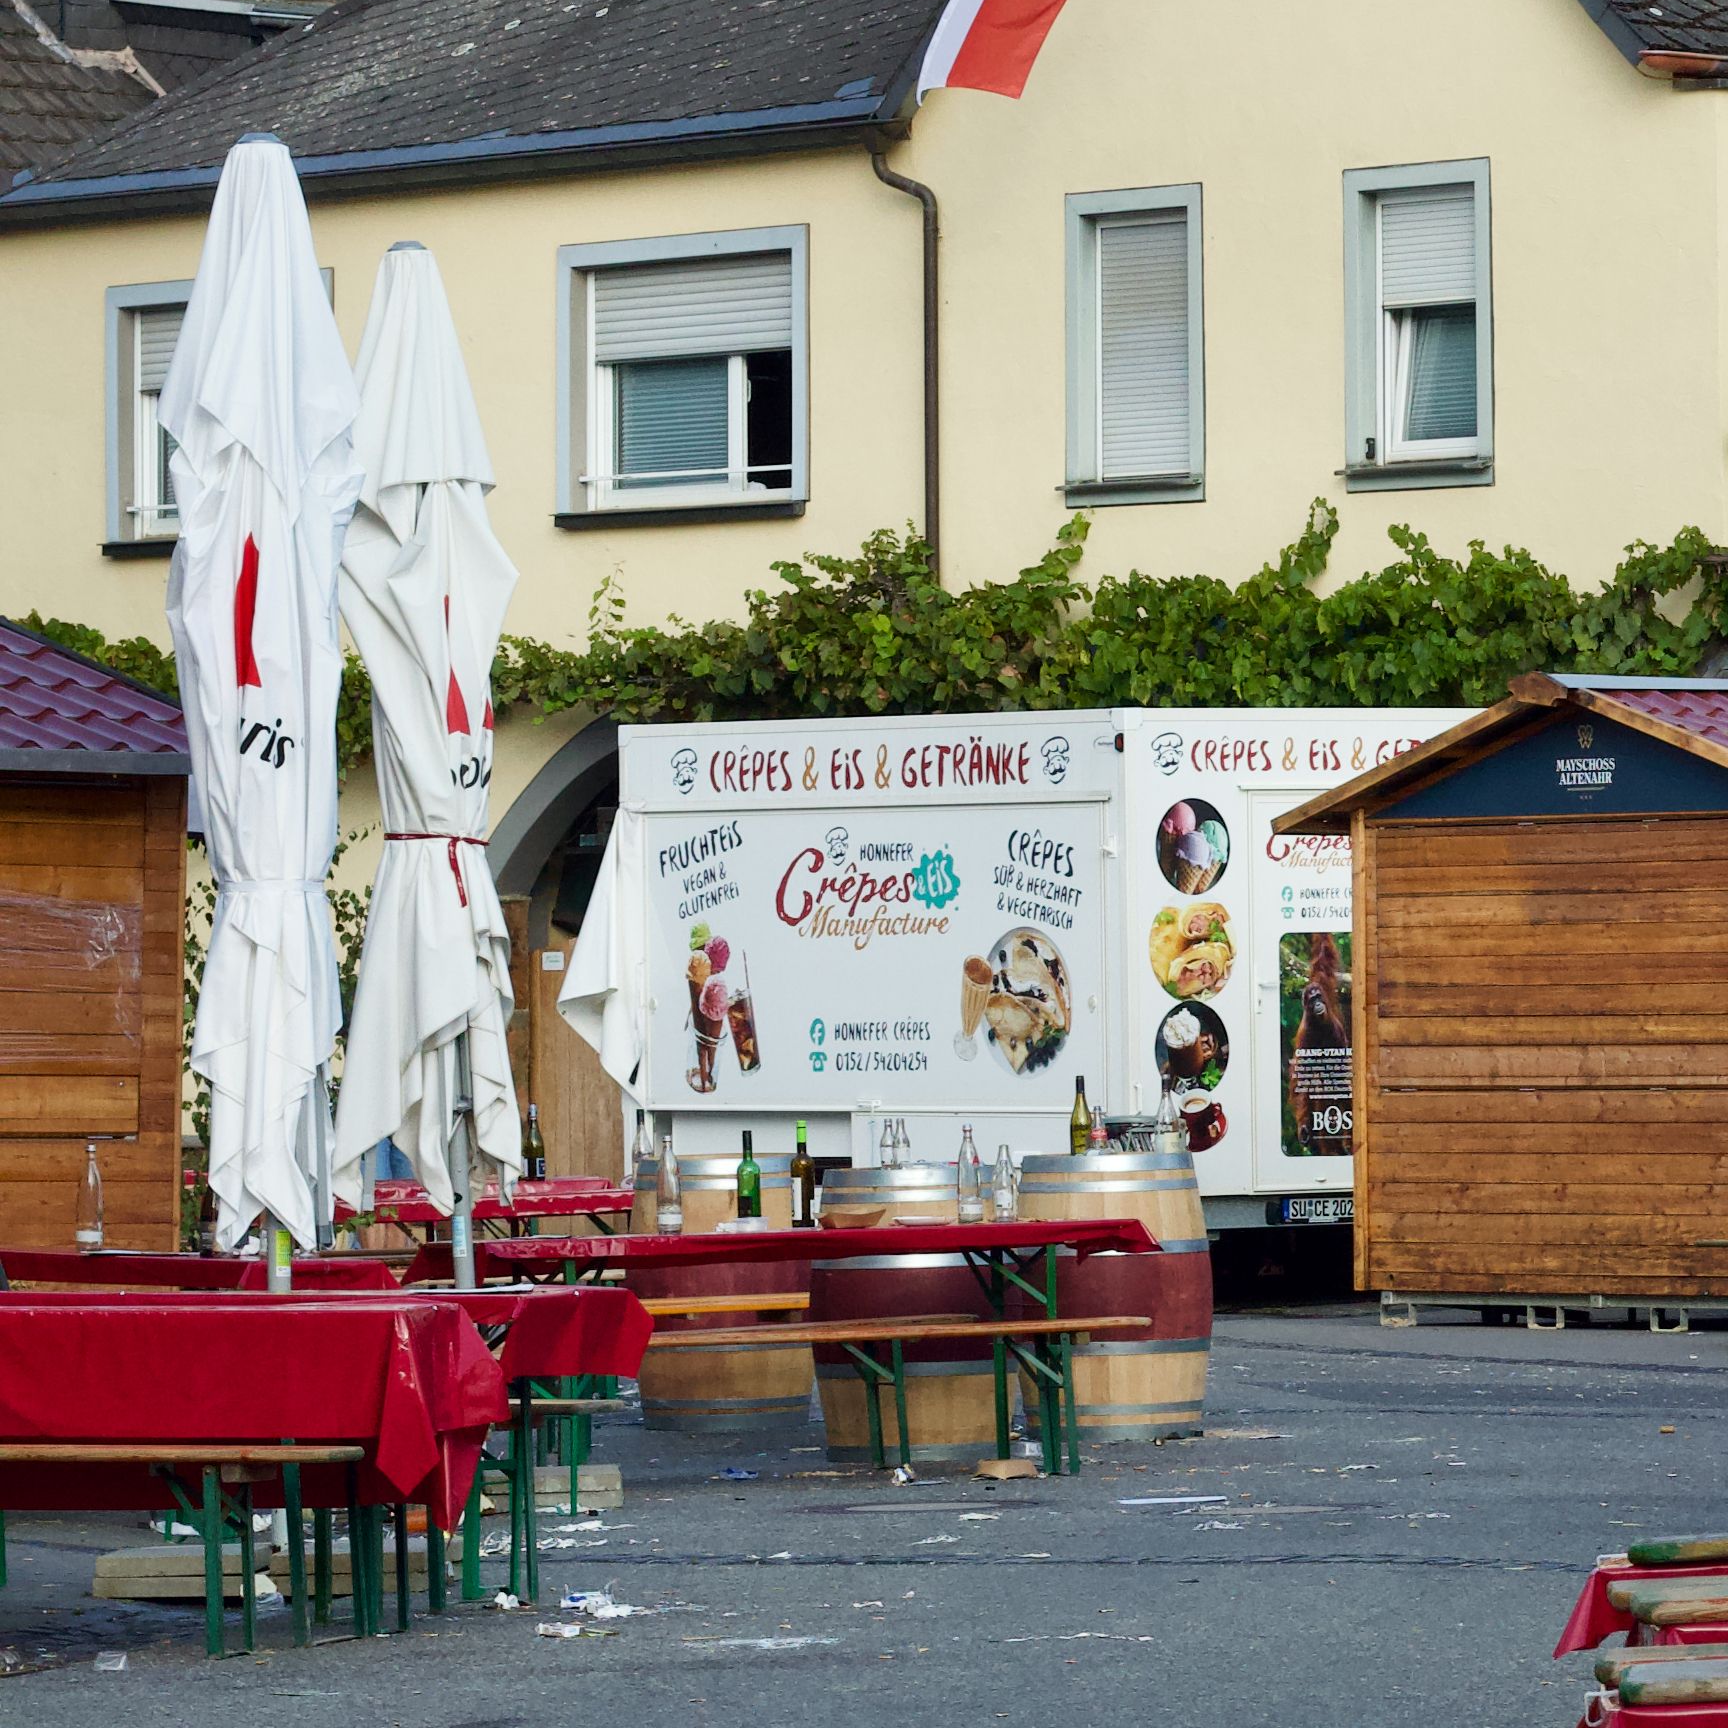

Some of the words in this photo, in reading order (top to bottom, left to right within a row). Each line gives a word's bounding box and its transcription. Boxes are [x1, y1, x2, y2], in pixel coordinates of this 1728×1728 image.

[709, 744, 792, 793] CRÊPES
[802, 746, 819, 791] &
[874, 743, 892, 790] &
[901, 736, 1031, 788] GETRÄNKE
[1191, 736, 1272, 772] CRÊPES
[1282, 737, 1297, 772] &
[1350, 737, 1366, 771] &
[1556, 758, 1616, 772] MAYSCHOSS
[1559, 772, 1612, 785] ALTENAHR
[860, 843, 913, 862] HONNEFER
[1008, 828, 1074, 877] CRÊPES
[683, 866, 717, 894] VEGAN
[719, 862, 727, 879] &
[775, 847, 915, 926] Crêpes
[1016, 872, 1024, 890] &
[1027, 877, 1082, 907] HERZHAFT
[997, 892, 1005, 911] &
[799, 905, 952, 950] Manufacture
[834, 1022, 888, 1041] HONNEFER
[894, 1016, 931, 1040] CRÊPES
[1291, 1200, 1306, 1217] SU
[1315, 1200, 1329, 1216] CE
